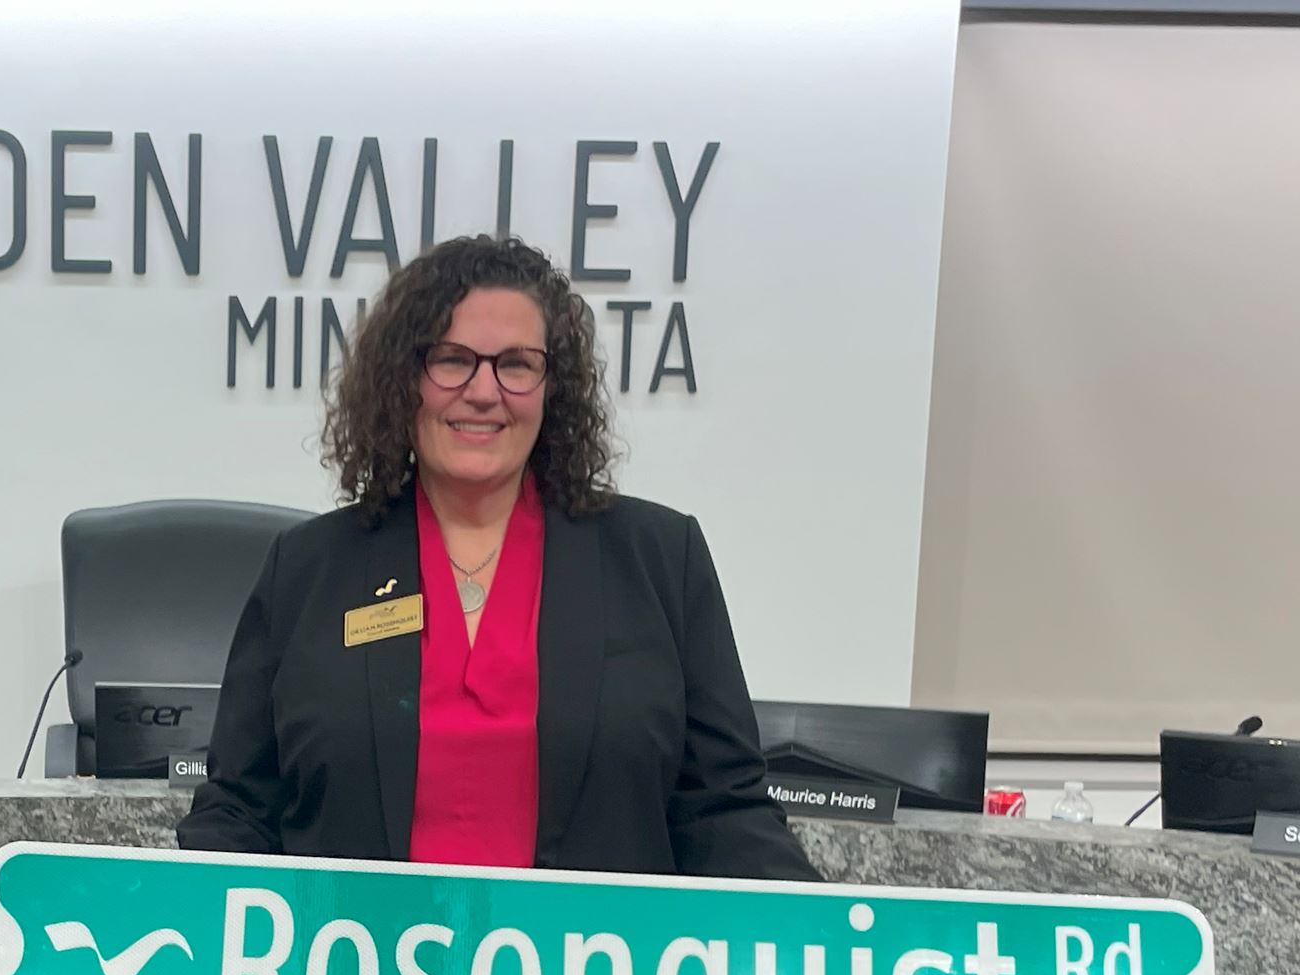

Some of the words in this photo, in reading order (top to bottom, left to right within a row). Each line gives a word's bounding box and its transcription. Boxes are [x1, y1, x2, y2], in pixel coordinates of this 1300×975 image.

[263, 135, 721, 283] VALLEY
[227, 295, 698, 394] MINTA
[767, 785, 826, 805] Maurice
[830, 791, 876, 810] Harris
